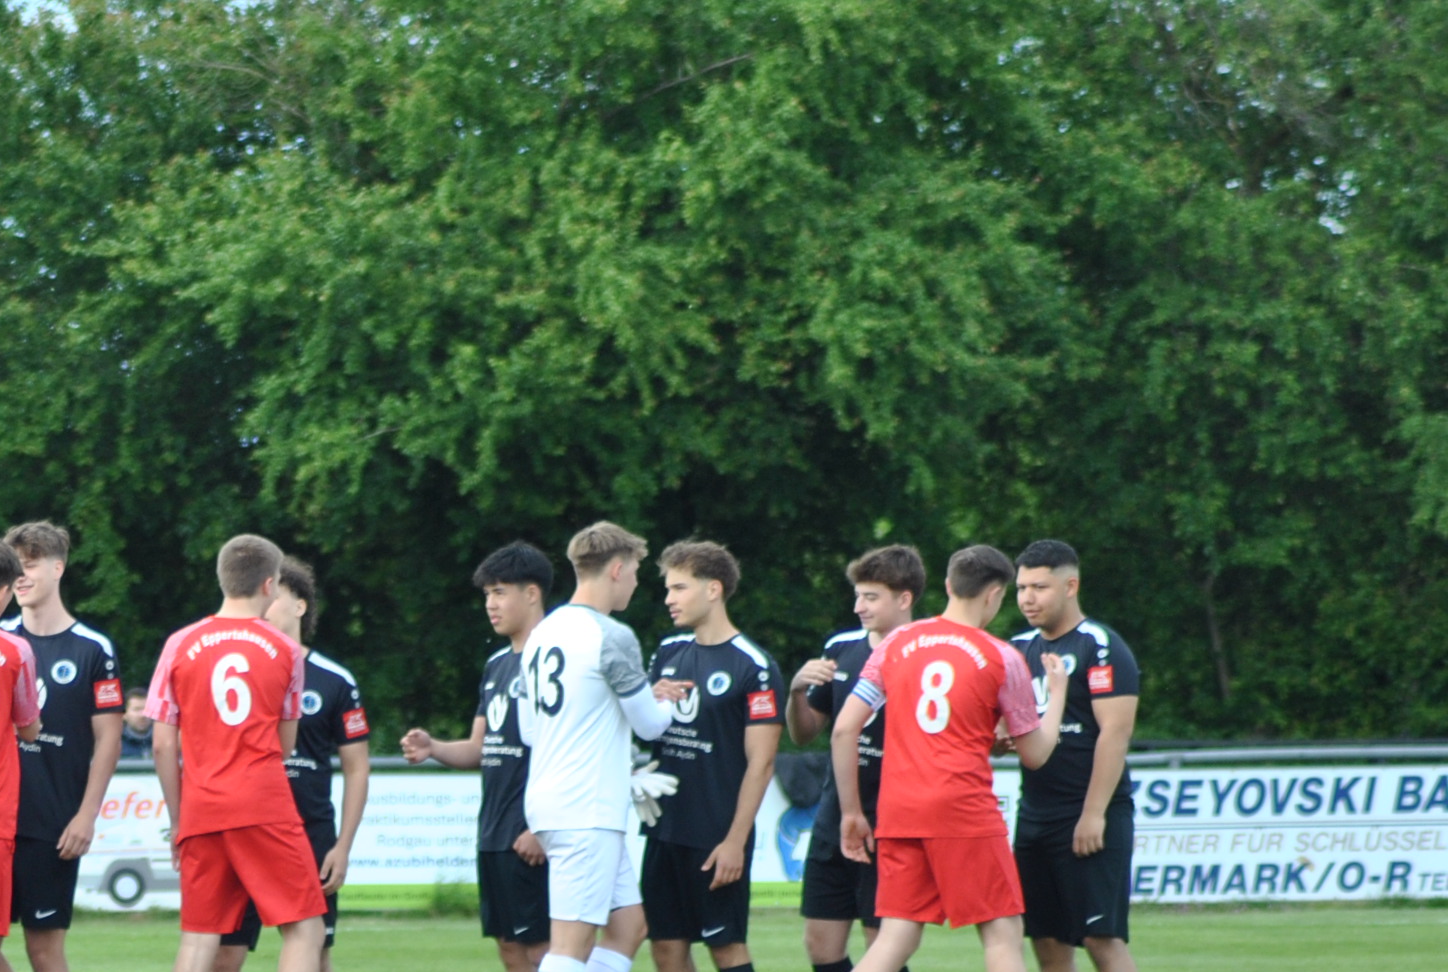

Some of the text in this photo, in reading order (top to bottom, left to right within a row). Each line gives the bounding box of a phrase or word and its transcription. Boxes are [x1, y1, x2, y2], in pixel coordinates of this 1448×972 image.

[186, 629, 279, 660] FV Eppertshausen
[901, 634, 988, 670] FV Eppertshausen
[210, 652, 252, 727] 6
[528, 646, 566, 718] 13
[915, 660, 955, 734] 8
[1230, 826, 1284, 854] FÜR
[1294, 824, 1448, 852] SCHLÜSSEL
